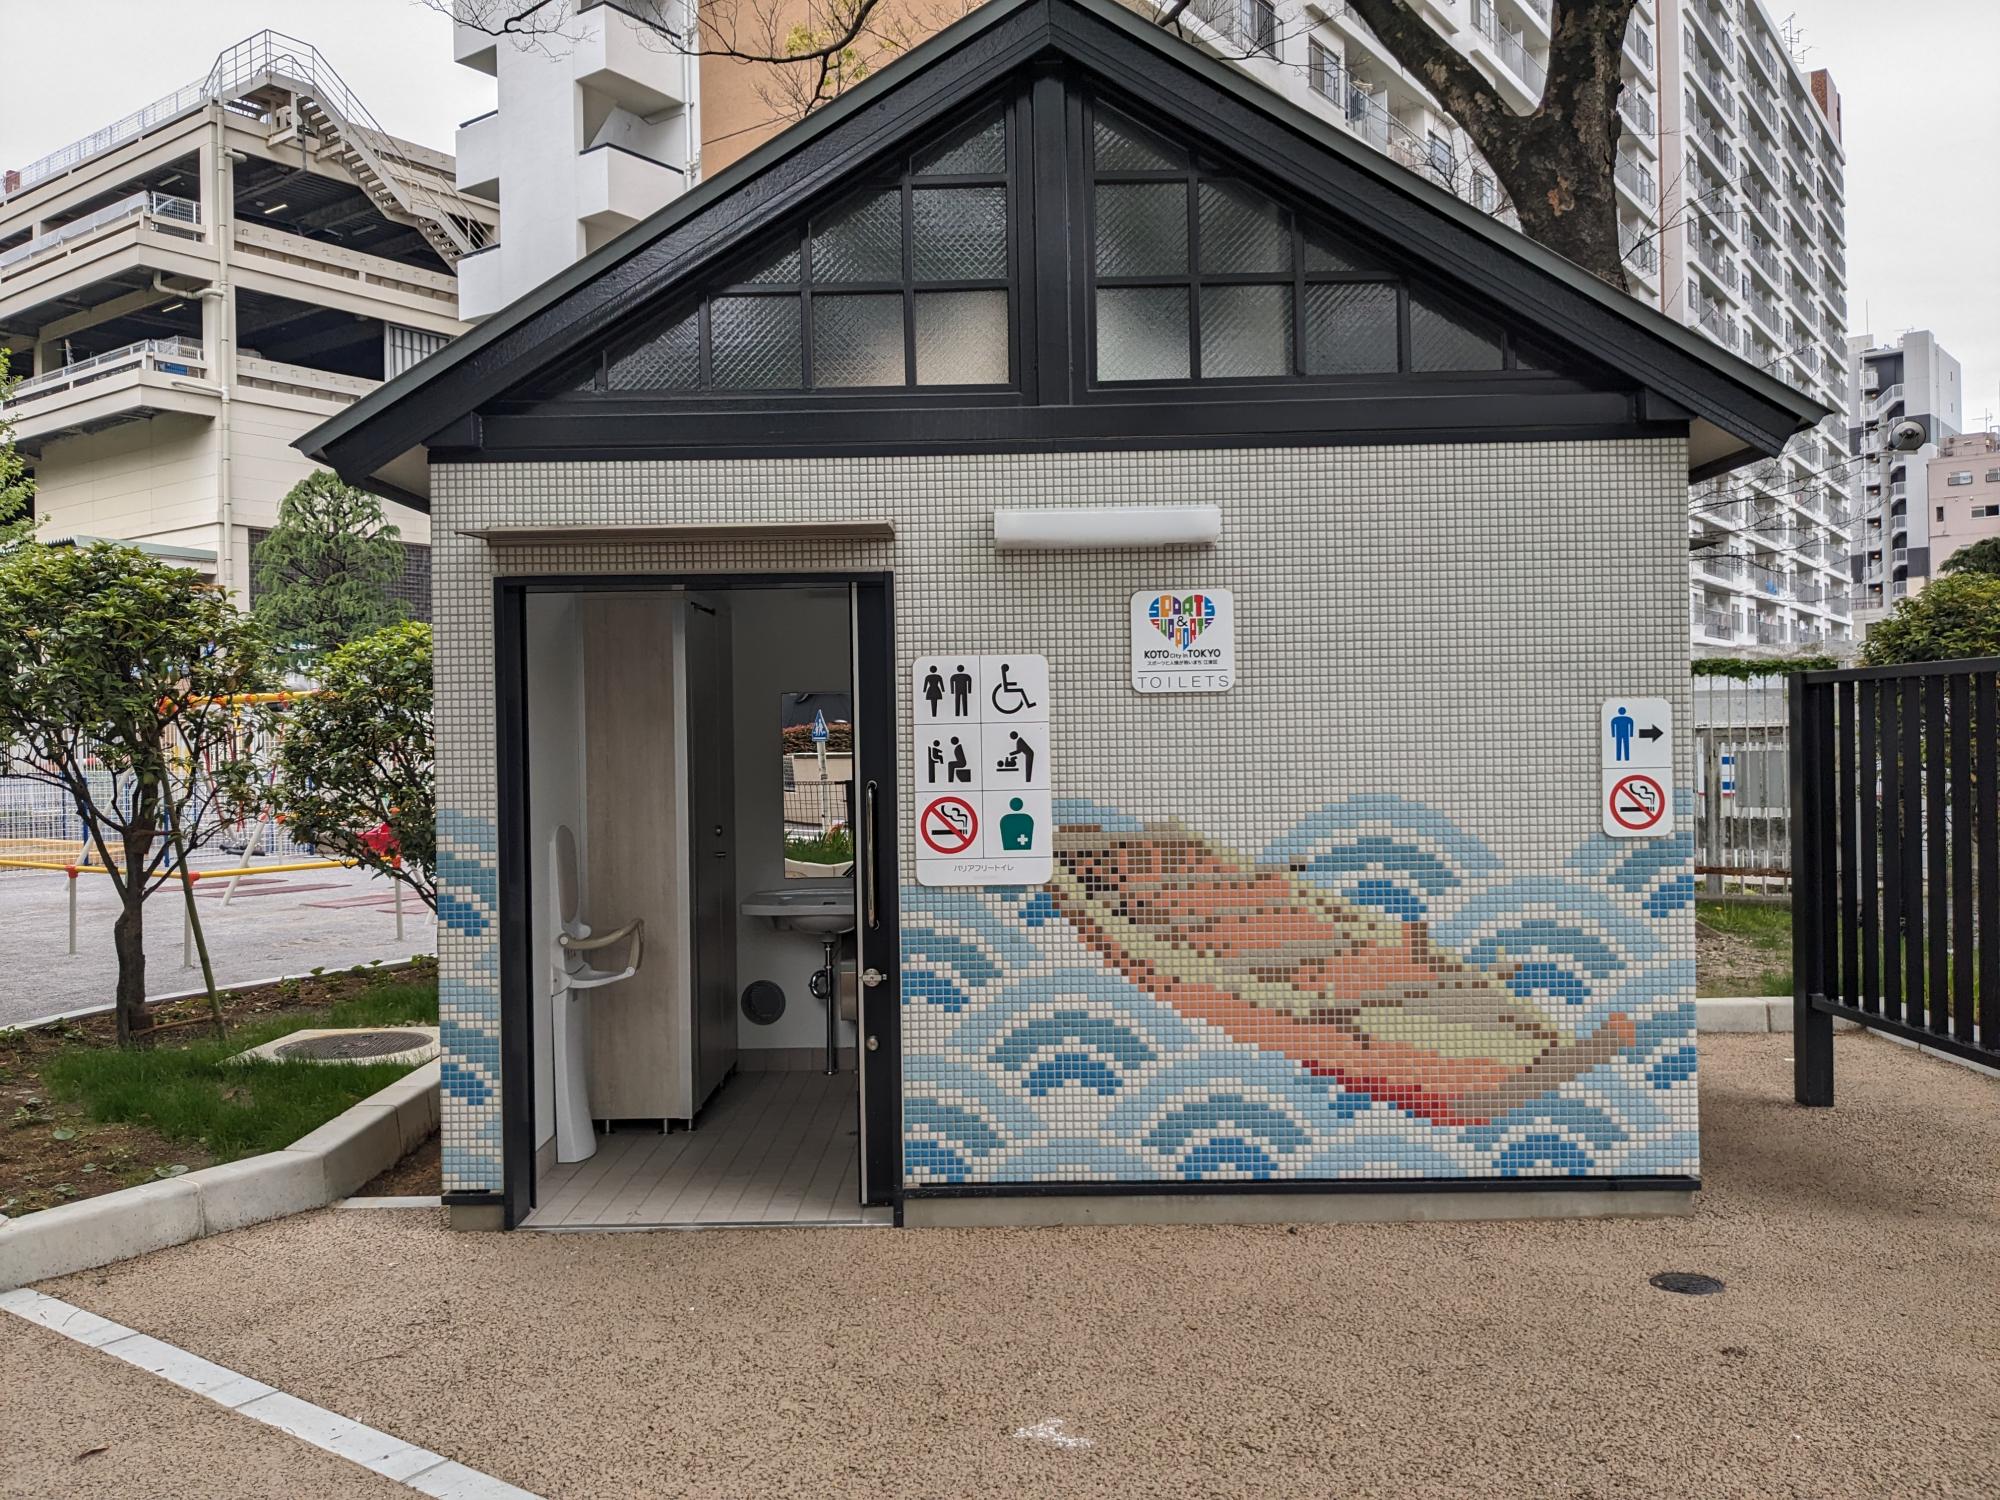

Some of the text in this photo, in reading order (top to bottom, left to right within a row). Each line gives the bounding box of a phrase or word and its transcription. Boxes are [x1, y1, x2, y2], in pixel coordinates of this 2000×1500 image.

[1148, 594, 1216, 618] SPORTS
[1176, 615, 1188, 627] &
[1144, 649, 1170, 659] KOTO
[1187, 648, 1221, 658] TOKYO
[1137, 675, 1229, 689] TOILETS
[953, 864, 1015, 873] バリアフリートイレ
